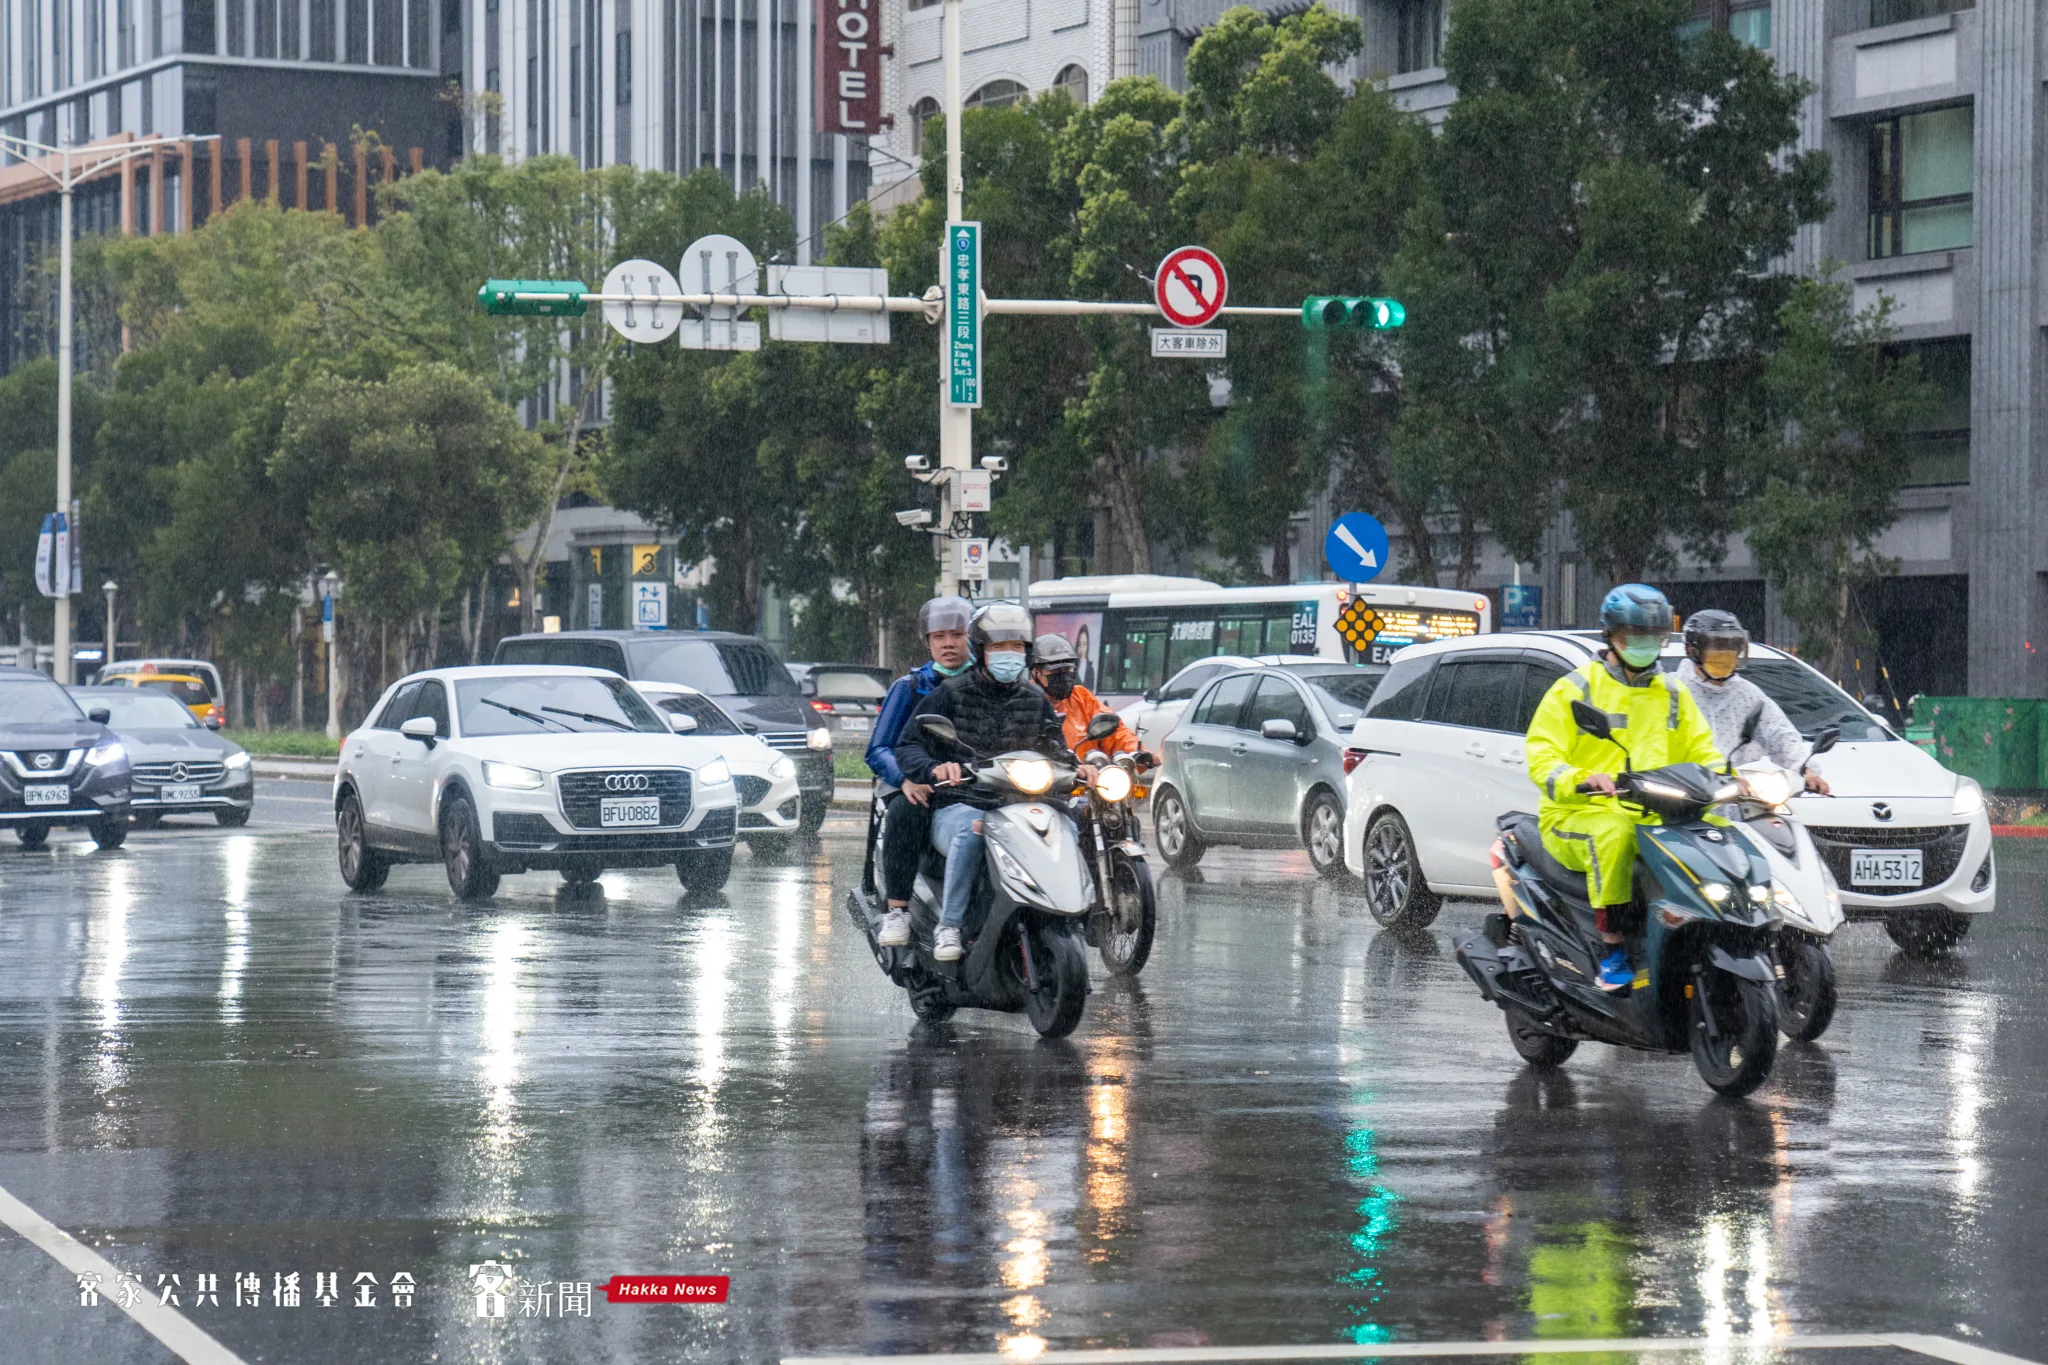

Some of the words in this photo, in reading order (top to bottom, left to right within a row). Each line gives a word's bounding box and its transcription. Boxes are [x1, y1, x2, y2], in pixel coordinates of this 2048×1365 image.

[957, 253, 969, 339] 忠孝東路三段
[1160, 336, 1219, 350] 大客車除外
[1504, 587, 1521, 613] P
[1292, 613, 1315, 628] EAL
[1291, 630, 1314, 644] 0135
[603, 805, 657, 822] BFU-0882
[1854, 860, 1920, 880] AHA-5312
